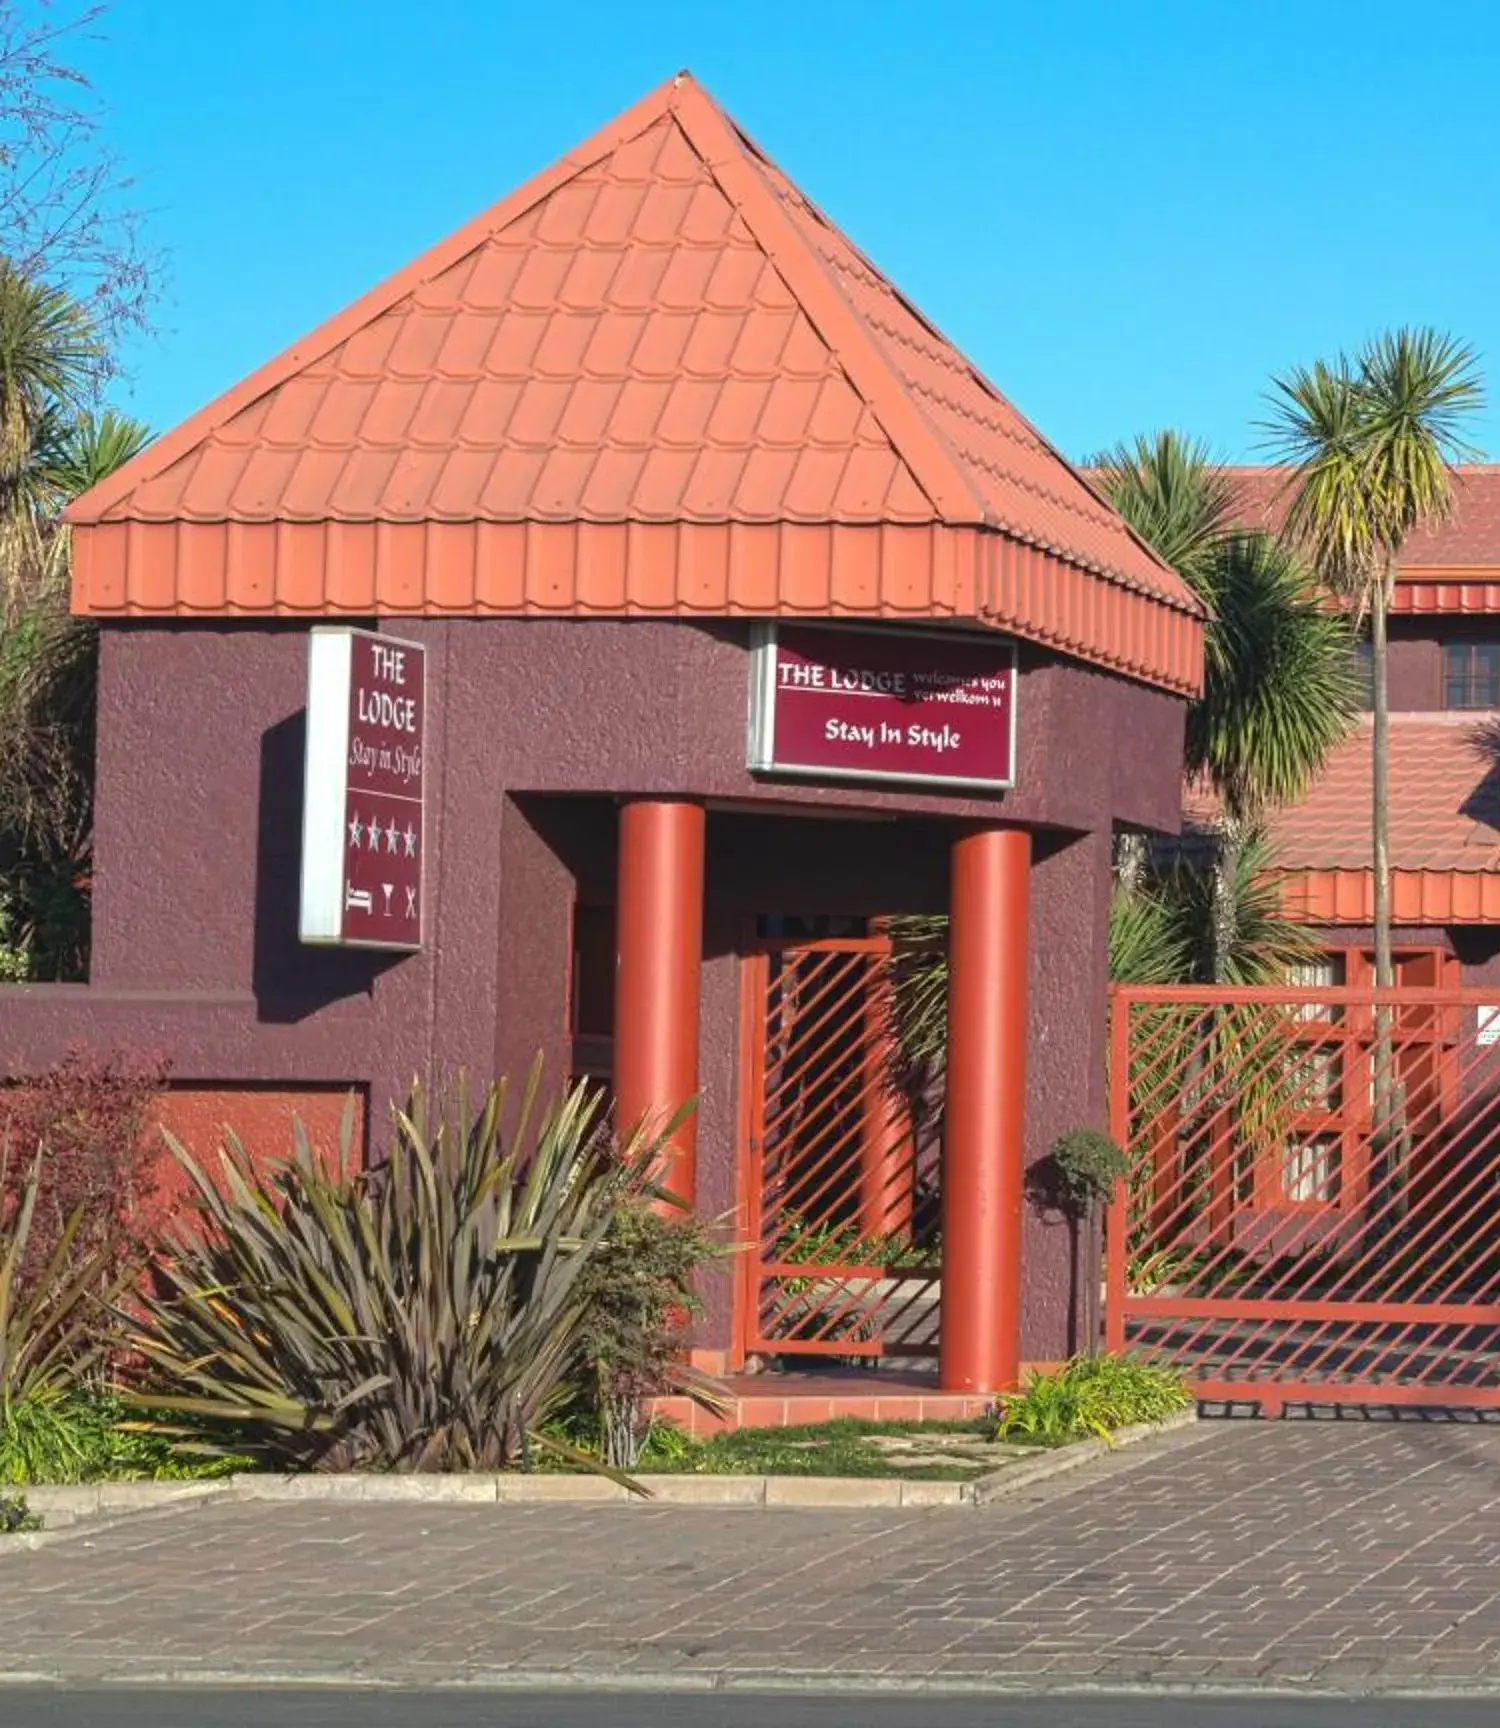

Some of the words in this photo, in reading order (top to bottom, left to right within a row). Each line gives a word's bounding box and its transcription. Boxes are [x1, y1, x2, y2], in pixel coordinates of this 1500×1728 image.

[371, 645, 406, 685] THE
[778, 663, 825, 687] THE
[830, 668, 906, 693] LODGE
[981, 678, 1006, 692] you
[359, 687, 416, 733] LODGE
[825, 718, 875, 749] Stay
[880, 721, 901, 744] In
[907, 724, 961, 753] Style
[349, 736, 377, 777] Stay
[380, 741, 391, 769] in
[392, 744, 421, 784] Style
